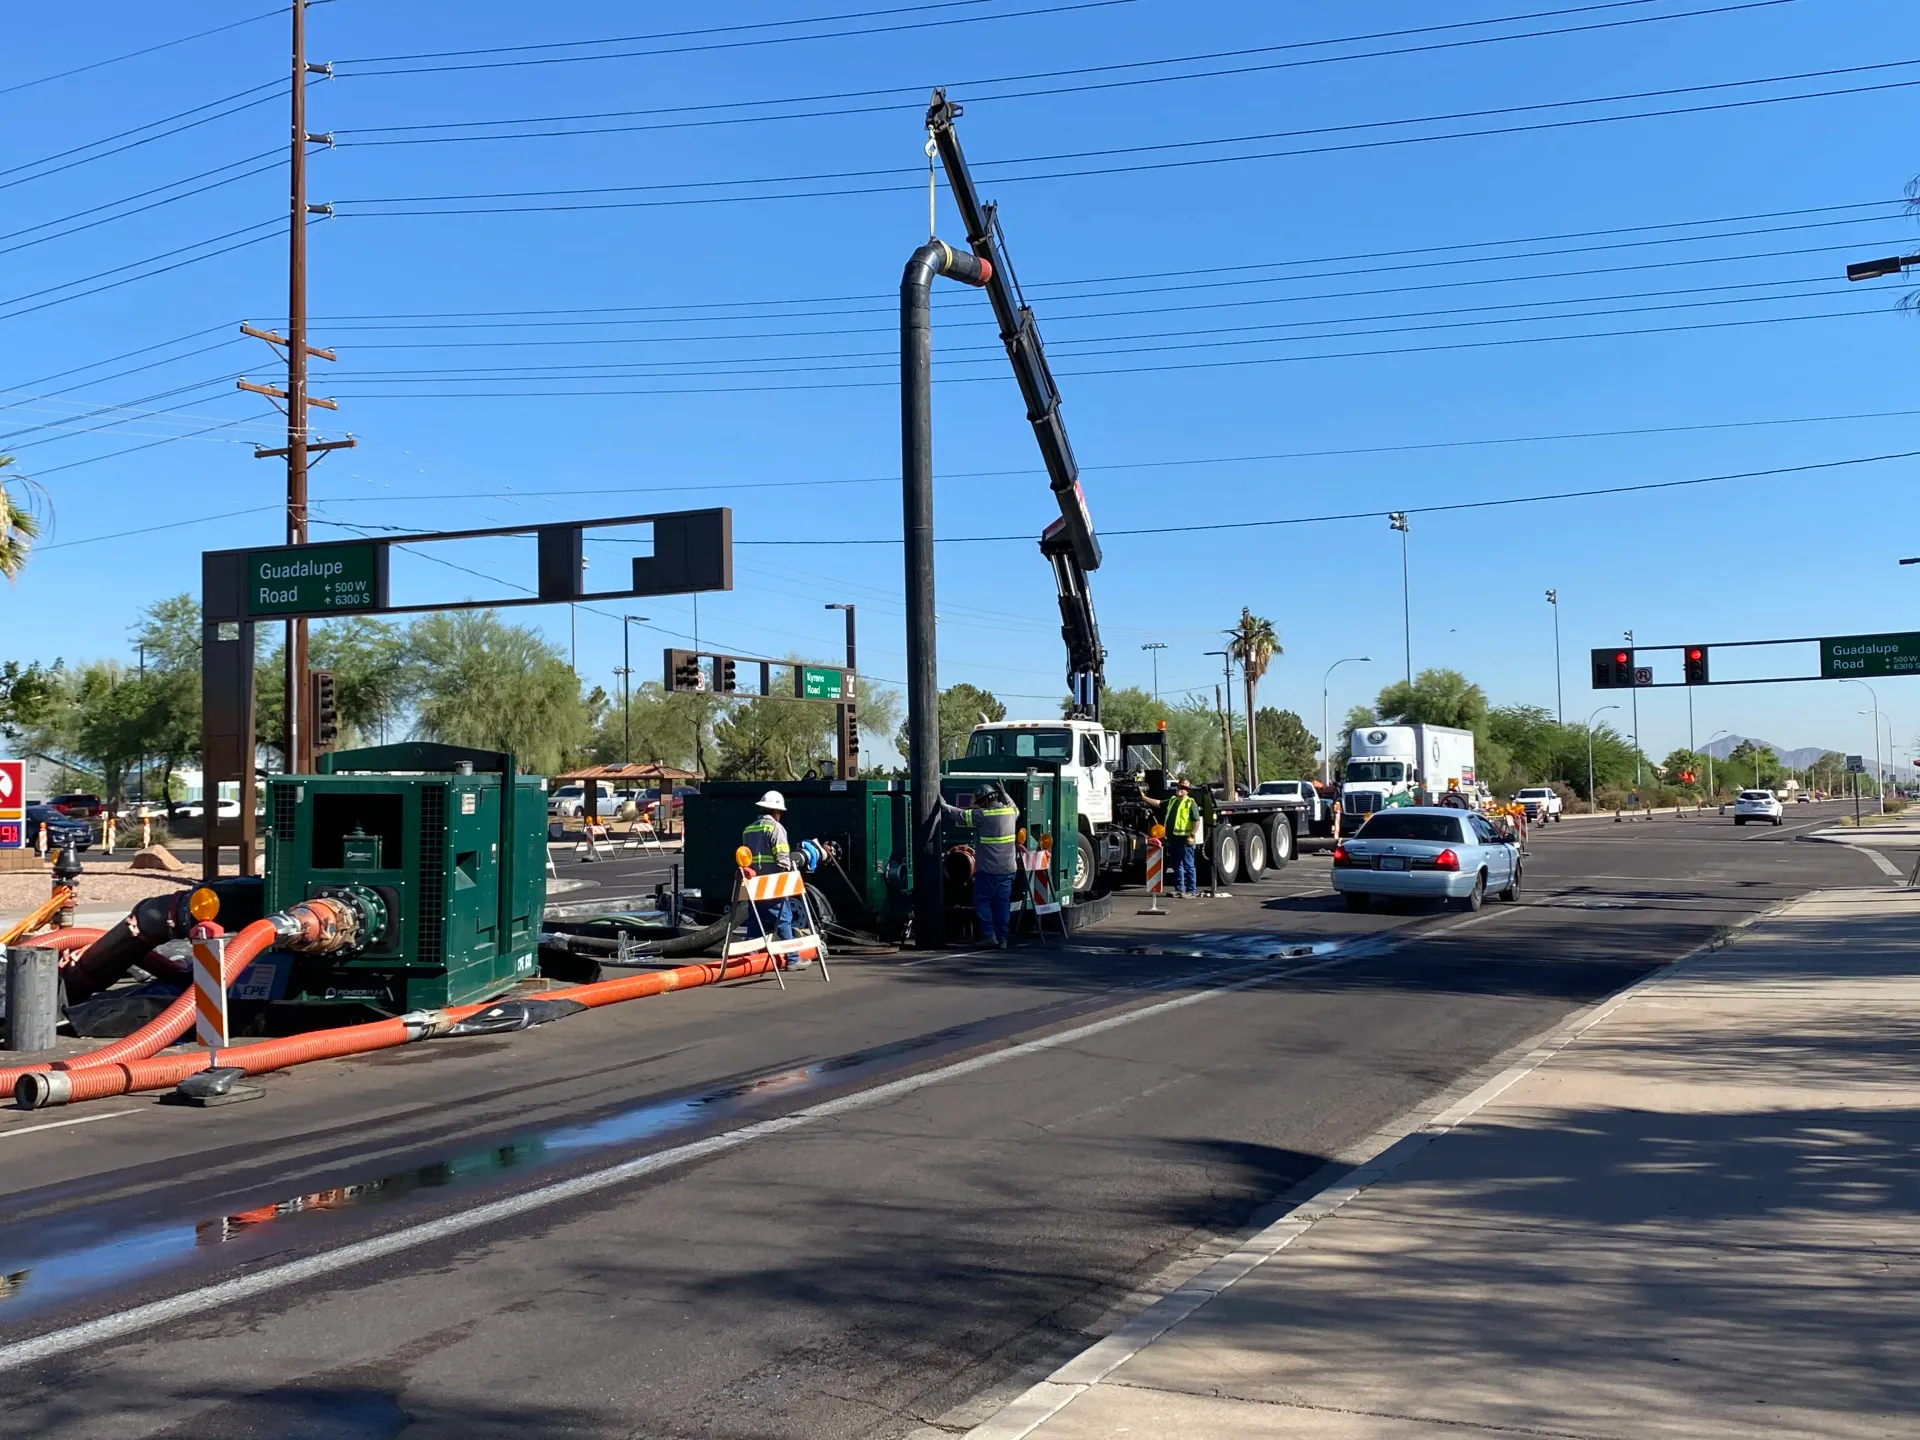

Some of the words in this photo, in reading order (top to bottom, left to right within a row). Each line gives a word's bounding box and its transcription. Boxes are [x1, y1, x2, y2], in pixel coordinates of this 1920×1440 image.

[260, 560, 343, 579] Guadalupe
[335, 582, 354, 592] 500
[355, 581, 367, 591] W
[260, 586, 298, 603] Road
[335, 595, 360, 605] 6300
[362, 593, 370, 603] S
[1833, 644, 1898, 655] Guadalupe
[1833, 659, 1864, 669] Road
[807, 673, 824, 683] Kyrene
[808, 685, 820, 694] Road
